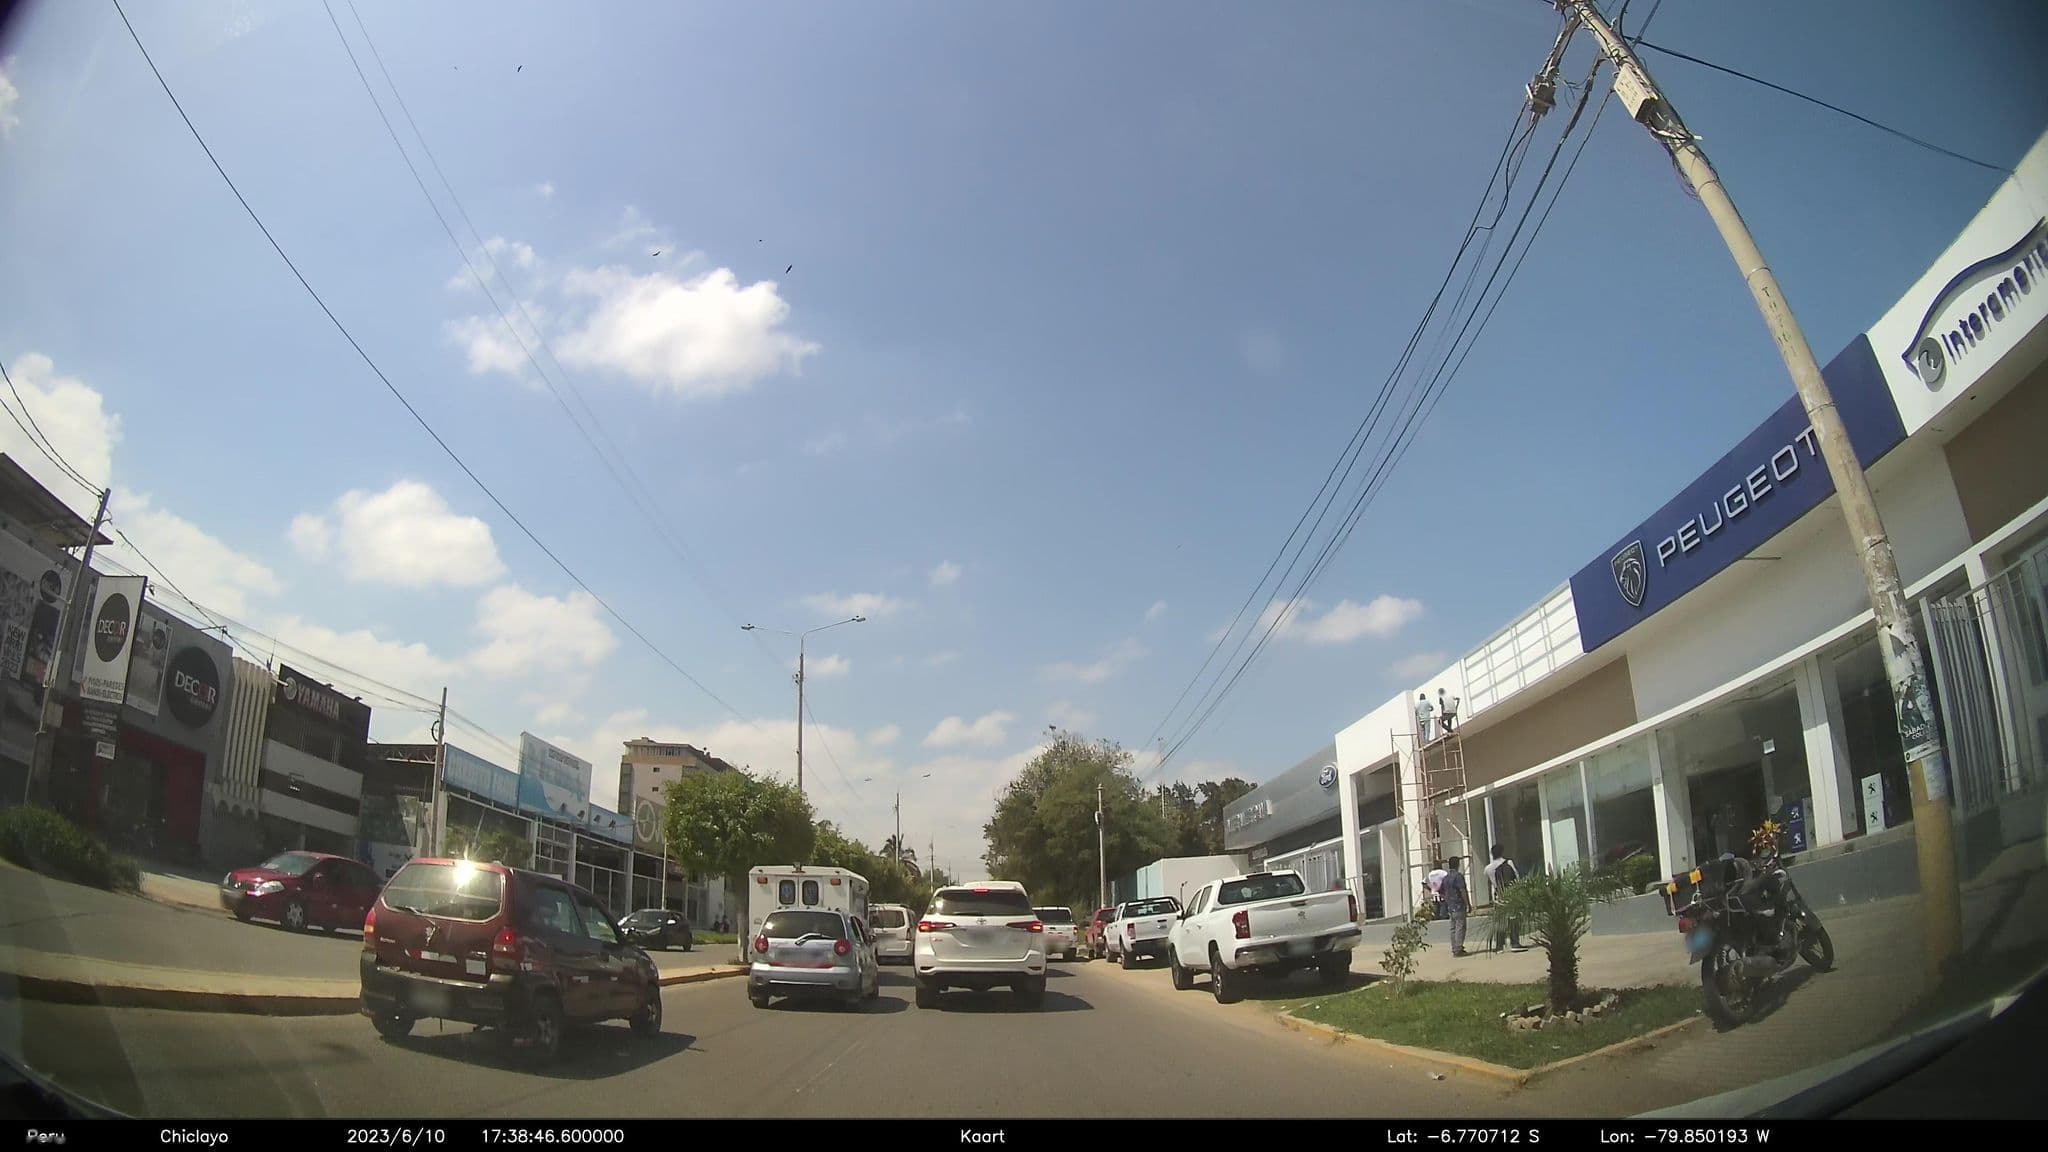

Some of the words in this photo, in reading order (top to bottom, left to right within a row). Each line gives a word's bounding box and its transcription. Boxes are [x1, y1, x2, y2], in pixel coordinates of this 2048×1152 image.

[1941, 230, 2048, 364] Interameric
[1656, 424, 1816, 568] PEUGEOT
[174, 668, 217, 705] DECOR
[298, 682, 340, 720] YAMAHA
